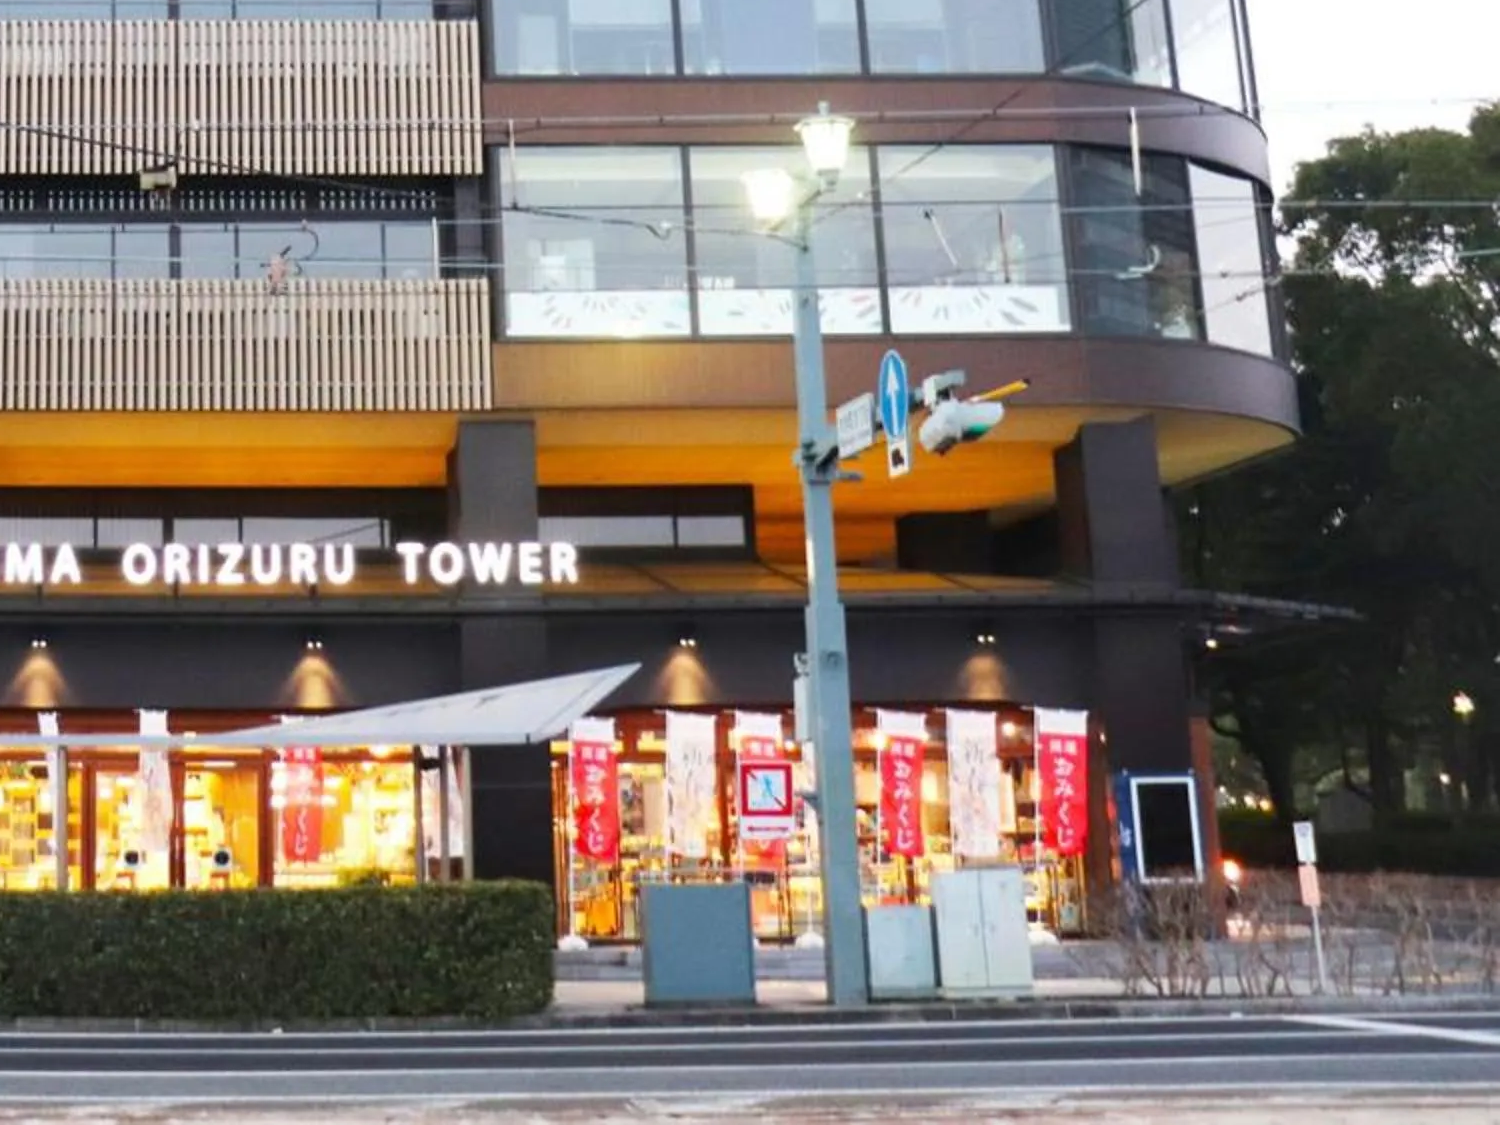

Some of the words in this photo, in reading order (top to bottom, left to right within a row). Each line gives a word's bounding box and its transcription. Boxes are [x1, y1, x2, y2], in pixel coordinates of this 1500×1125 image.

[121, 542, 355, 584] ORIZURU
[396, 542, 579, 584] TOWER
[893, 760, 916, 850] おみくじ
[1053, 756, 1077, 849] おみくじ
